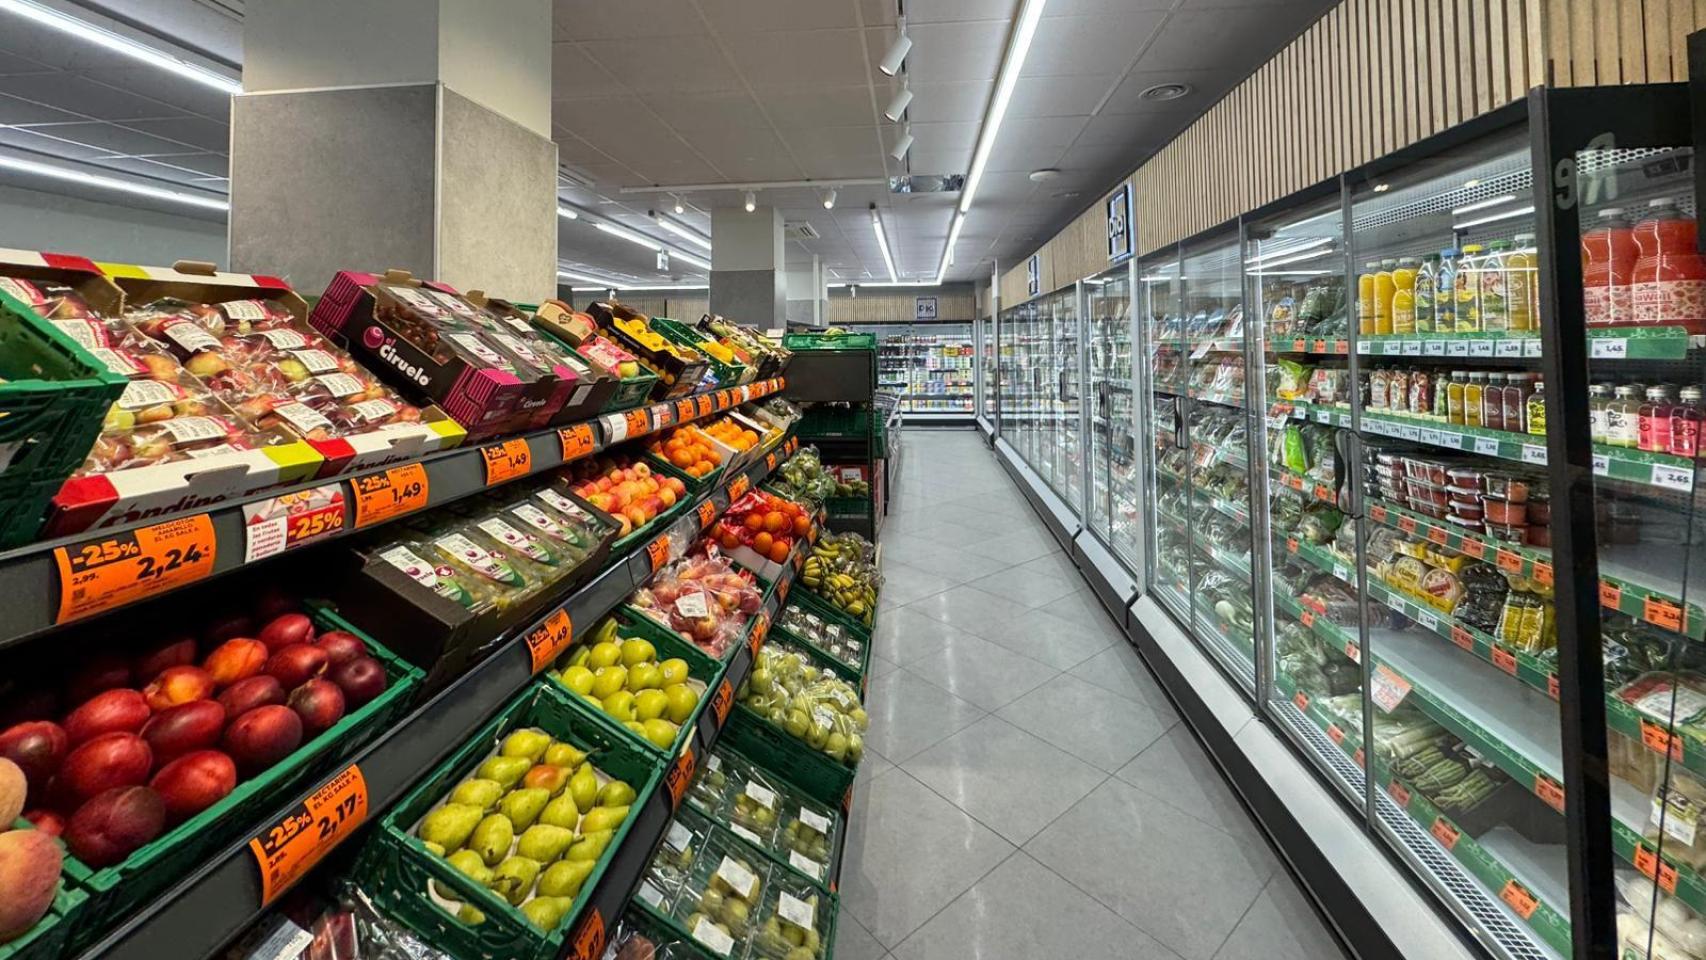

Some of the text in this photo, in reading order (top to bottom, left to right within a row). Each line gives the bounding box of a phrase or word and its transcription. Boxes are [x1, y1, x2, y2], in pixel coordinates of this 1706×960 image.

[379, 345, 430, 386] Ciruelo
[509, 453, 527, 468] 1,49
[360, 475, 390, 492] -25%
[392, 482, 422, 504] 1,49
[288, 510, 342, 540] -25%
[72, 538, 139, 567] -25%
[137, 543, 202, 580] 2,24
[312, 770, 351, 801] NECTARINA
[265, 812, 311, 850] -25%
[317, 793, 356, 839] 2,17
